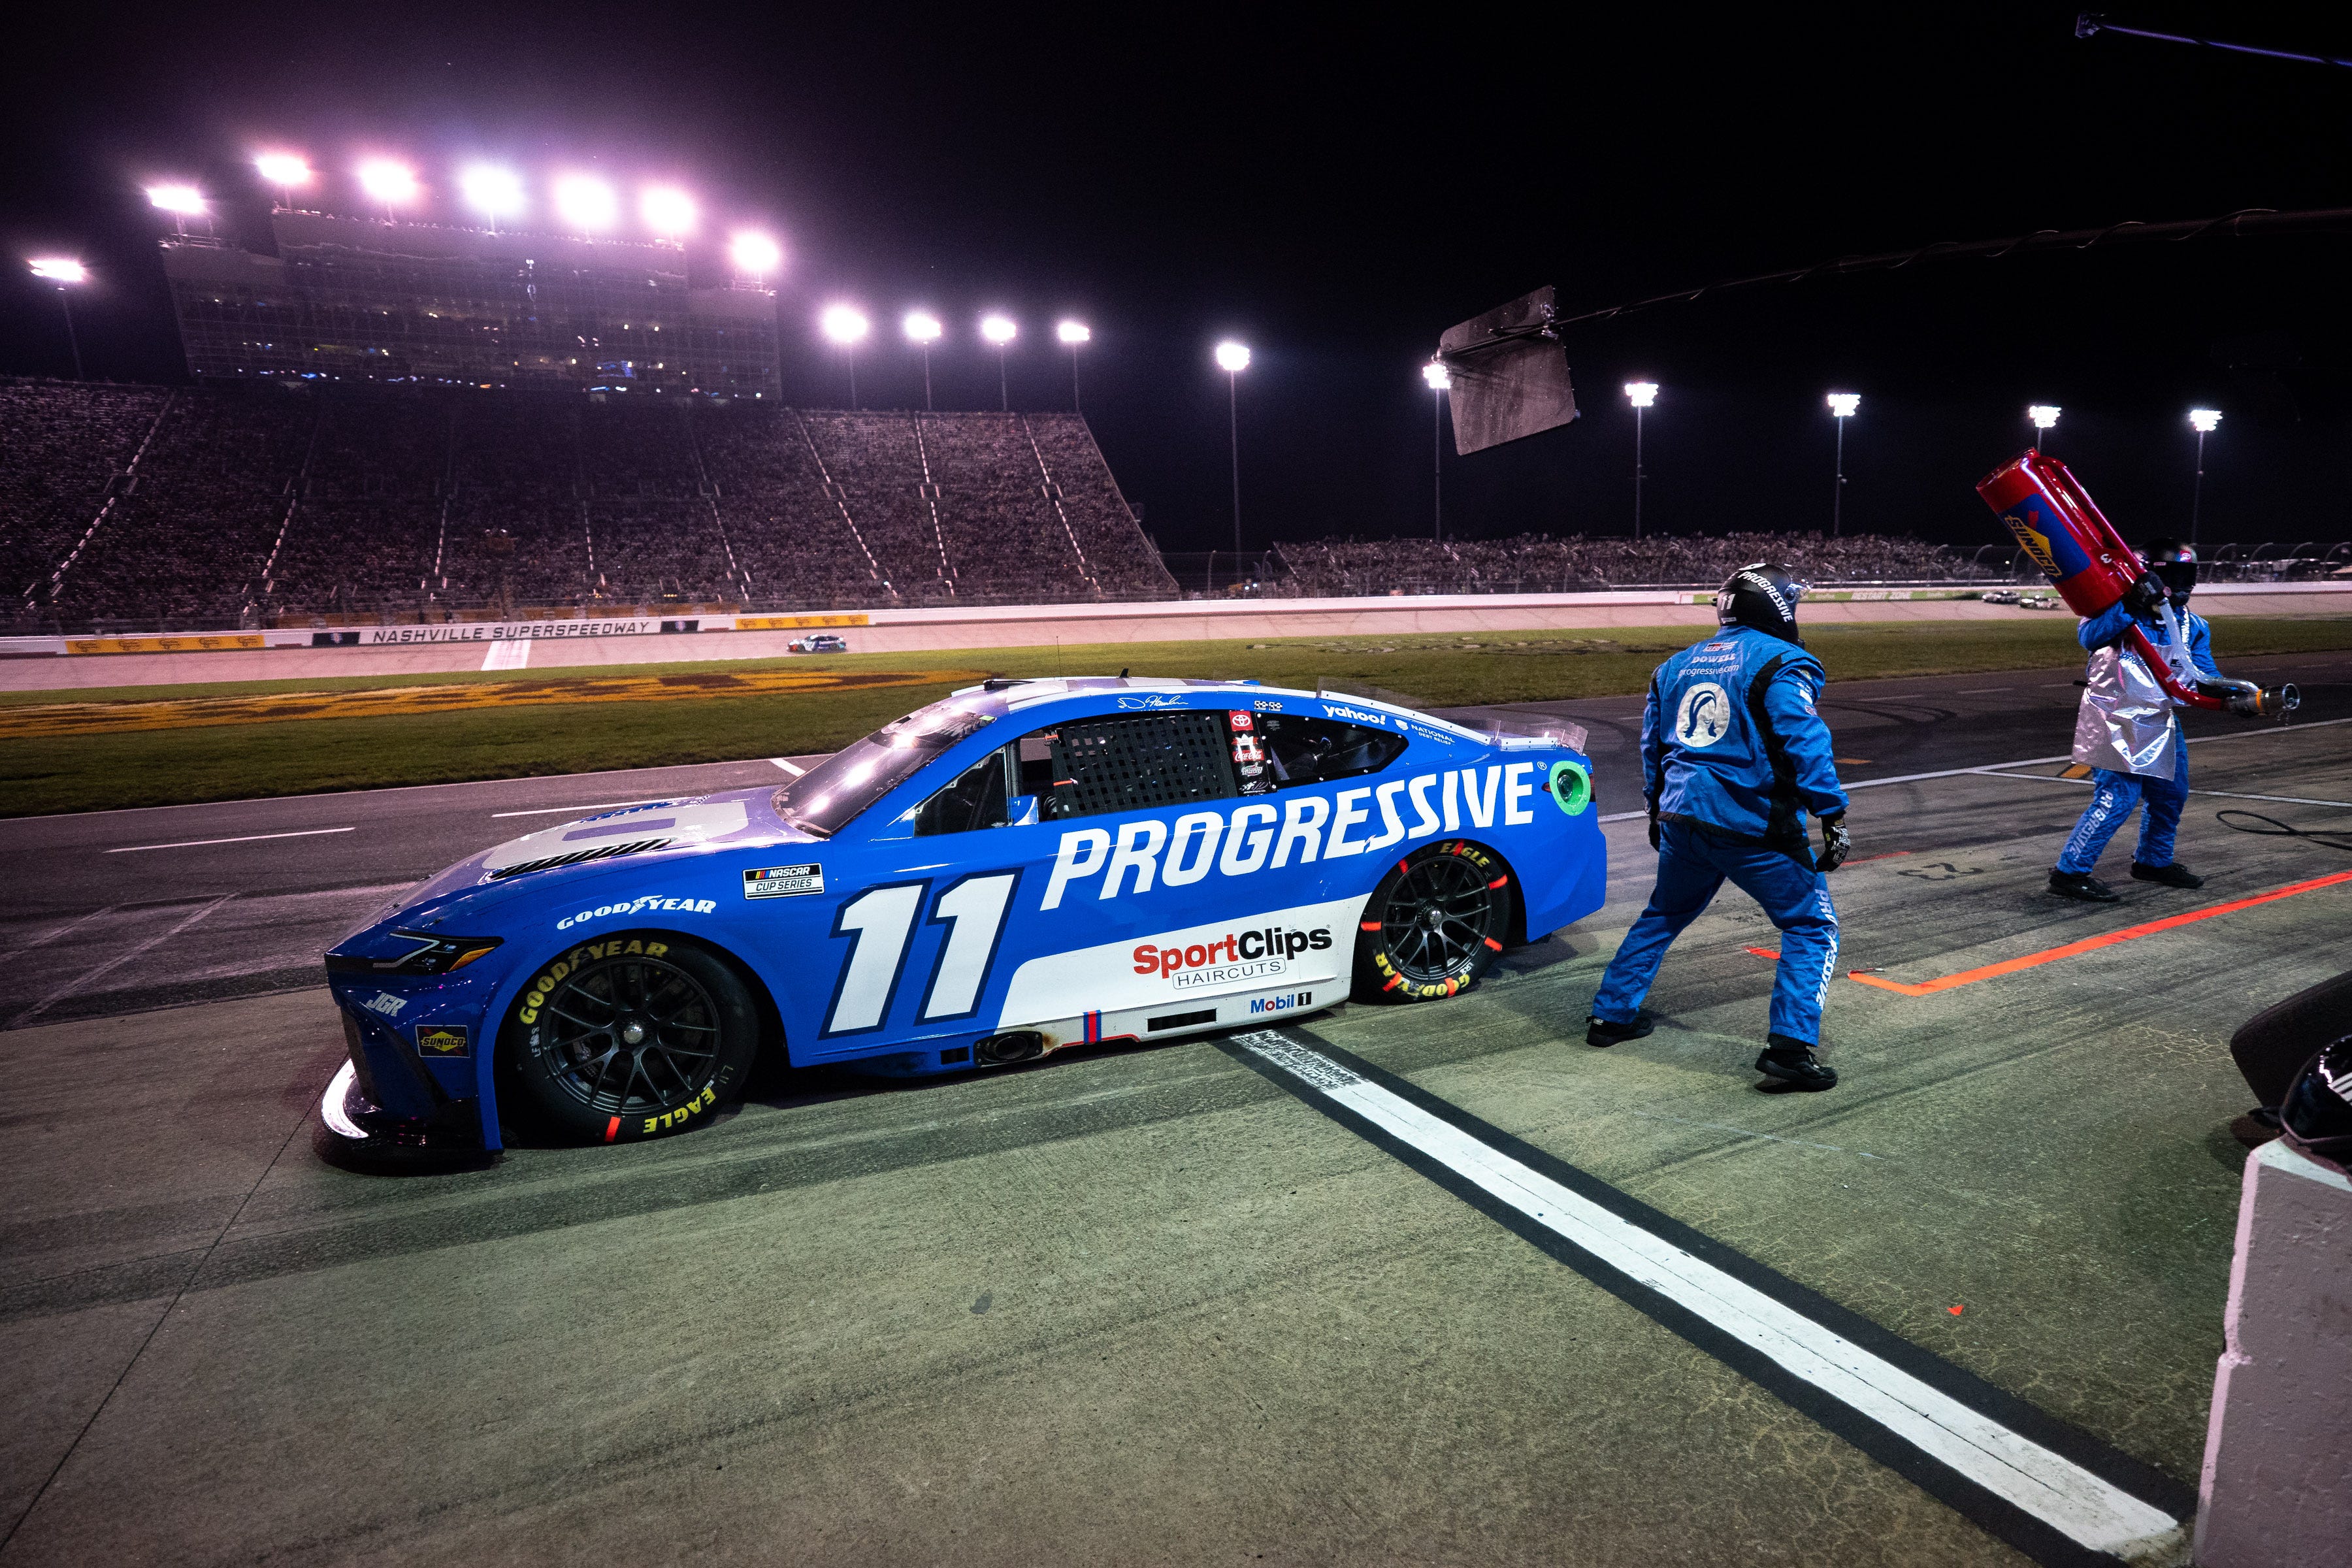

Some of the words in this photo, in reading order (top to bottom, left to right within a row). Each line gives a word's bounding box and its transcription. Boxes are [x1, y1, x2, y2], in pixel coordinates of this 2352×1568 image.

[2006, 516, 2061, 575] SUNOCO
[1721, 594, 1736, 611] 11
[1737, 571, 1793, 623] PROGRESSIVE
[374, 628, 484, 642] NASHVILLE
[493, 622, 650, 638] SUPERSPEEDWAY
[1691, 653, 1736, 664] DOWELL
[1678, 663, 1739, 677] progressive.com
[1322, 705, 1386, 725] yahoo!
[1411, 725, 1455, 743] NATIONAL
[1418, 732, 1433, 740] DEBT
[1433, 736, 1452, 746] RELIEF
[1039, 762, 1535, 911] PROGRESSIVE
[768, 866, 810, 878] NASCAR
[756, 882, 776, 891] CUP
[777, 879, 812, 890] SERIES
[557, 895, 717, 930] GOODYEAR
[825, 871, 1019, 1036] 11
[519, 940, 668, 1024] GOODYEAR
[1178, 960, 1281, 986] HAIRCUTS
[365, 992, 408, 1017] JGR
[1250, 994, 1295, 1013] Mobil
[1299, 992, 1309, 1005] 1
[421, 1037, 465, 1047] SUNOCO
[643, 1087, 716, 1134] EAGLE
